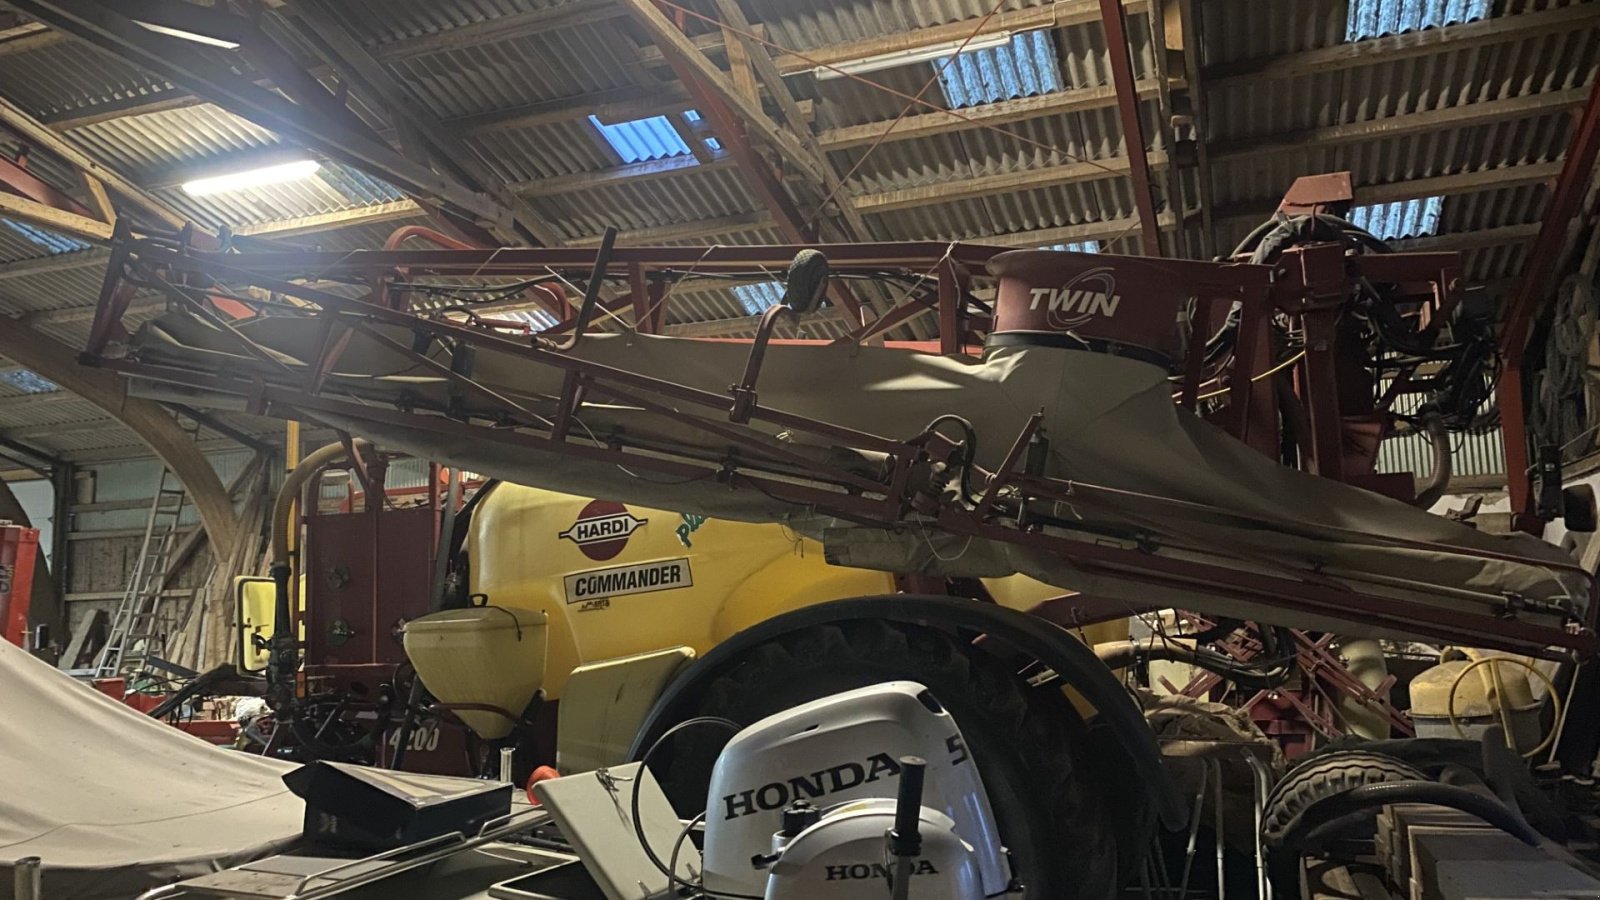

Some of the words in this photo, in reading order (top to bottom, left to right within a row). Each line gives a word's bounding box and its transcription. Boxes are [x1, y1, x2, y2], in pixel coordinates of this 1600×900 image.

[1029, 288, 1121, 317] TWIN
[577, 518, 629, 540] HARDI
[575, 564, 681, 597] COMMANDER
[722, 752, 901, 820] HONDA
[825, 860, 939, 880] HONA
